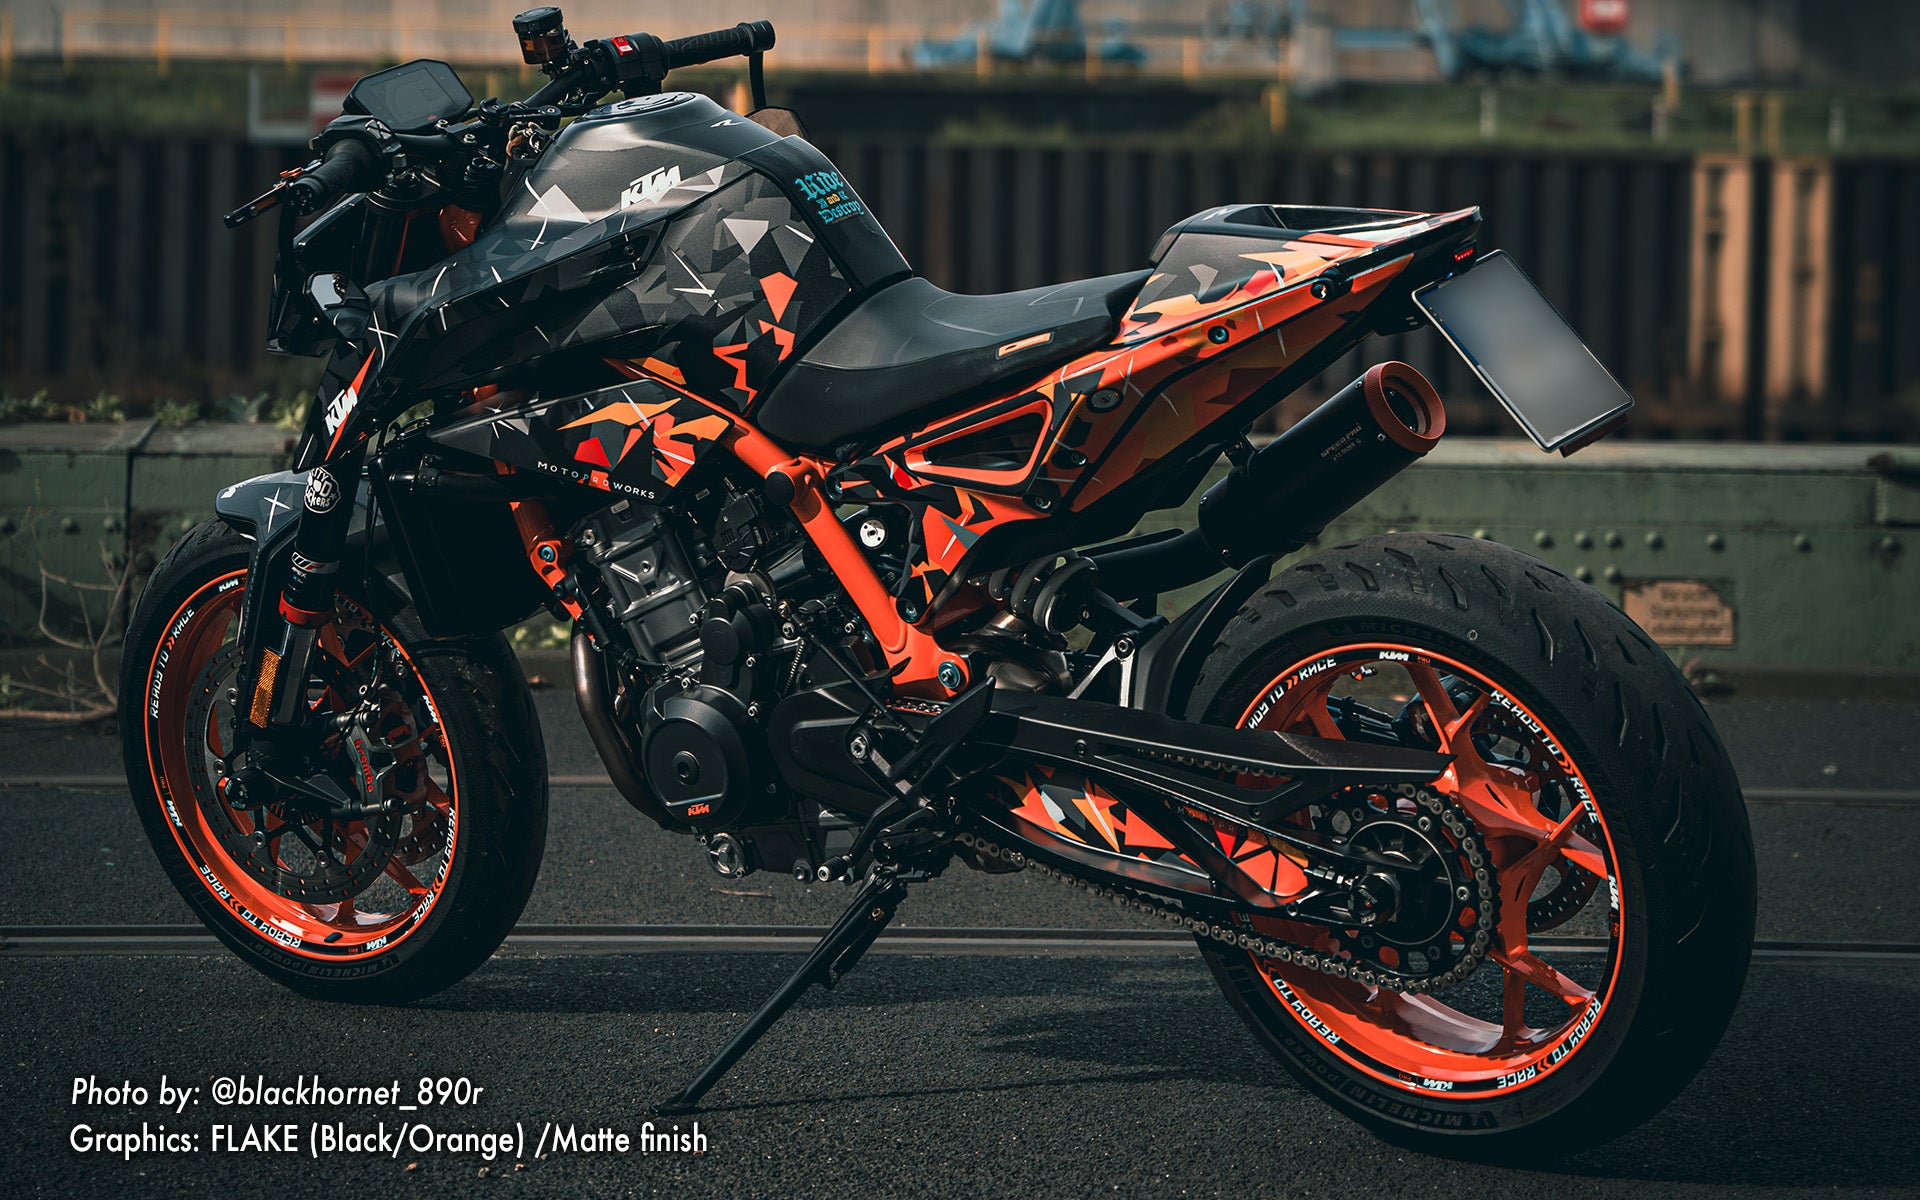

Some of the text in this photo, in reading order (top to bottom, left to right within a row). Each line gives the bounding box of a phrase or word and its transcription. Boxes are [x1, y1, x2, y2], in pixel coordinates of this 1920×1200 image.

[621, 165, 681, 210] KTM
[795, 171, 843, 200] Ride
[818, 200, 864, 224] Destroy
[324, 385, 358, 437] KTM
[219, 578, 239, 593] KTM
[150, 606, 195, 720] READY TO RACE
[1379, 650, 1410, 662] KTM
[1270, 685, 1285, 704] TO
[1298, 655, 1337, 681] RACE
[422, 695, 440, 723] KTM
[354, 739, 374, 793] brembo
[1490, 690, 1543, 734] READY
[1541, 734, 1562, 756] TO
[1570, 776, 1602, 824] RACE
[166, 800, 183, 828] KTM
[687, 803, 711, 817] KTM
[412, 807, 456, 925] READY TO RACE
[199, 864, 302, 949] READY TO RACE
[1607, 874, 1620, 911] KTM
[366, 936, 387, 951] KTM
[1273, 978, 1341, 1045] READY TO
[1497, 997, 1602, 1089] READY TO RACE
[1422, 1078, 1453, 1092] KTM
